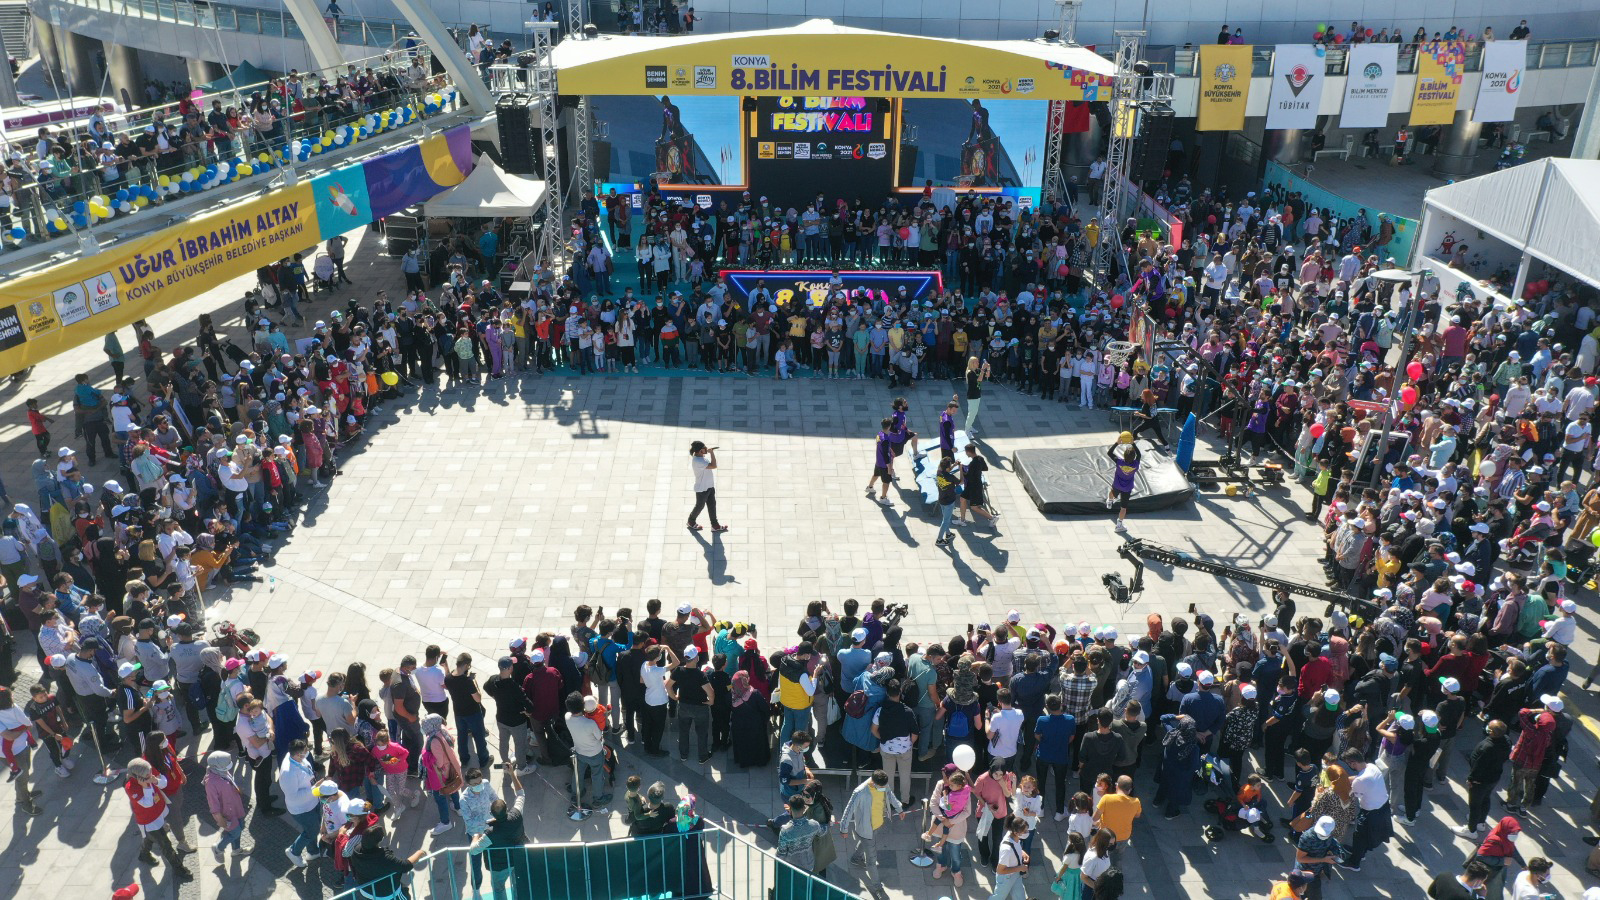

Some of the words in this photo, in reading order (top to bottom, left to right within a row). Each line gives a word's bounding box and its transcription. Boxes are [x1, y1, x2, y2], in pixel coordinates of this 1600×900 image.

[734, 56, 768, 66] KONYA
[730, 63, 820, 90] 8.BİLİM
[827, 64, 947, 92] FESTİVALİ
[1420, 81, 1448, 90] 8.BİLİM
[1418, 90, 1455, 100] FESTİVALİ
[1278, 100, 1310, 110] TÜBİTAK
[771, 112, 872, 133] FESTİVALİ
[118, 254, 177, 284] UĞUR
[178, 219, 252, 261] İBRAHİM
[256, 202, 300, 231] ALTAY
[125, 280, 164, 302] KONYA
[166, 252, 224, 287] BÜYÜKŞEHİR
[226, 237, 267, 262] BELEDİYE
[268, 222, 303, 246] BAŞKANI
[94, 294, 112, 303] KONYA
[98, 299, 110, 307] 2021
[774, 289, 794, 306] 8
[0, 315, 18, 330] ENİM
[0, 325, 21, 340] EHRİM
